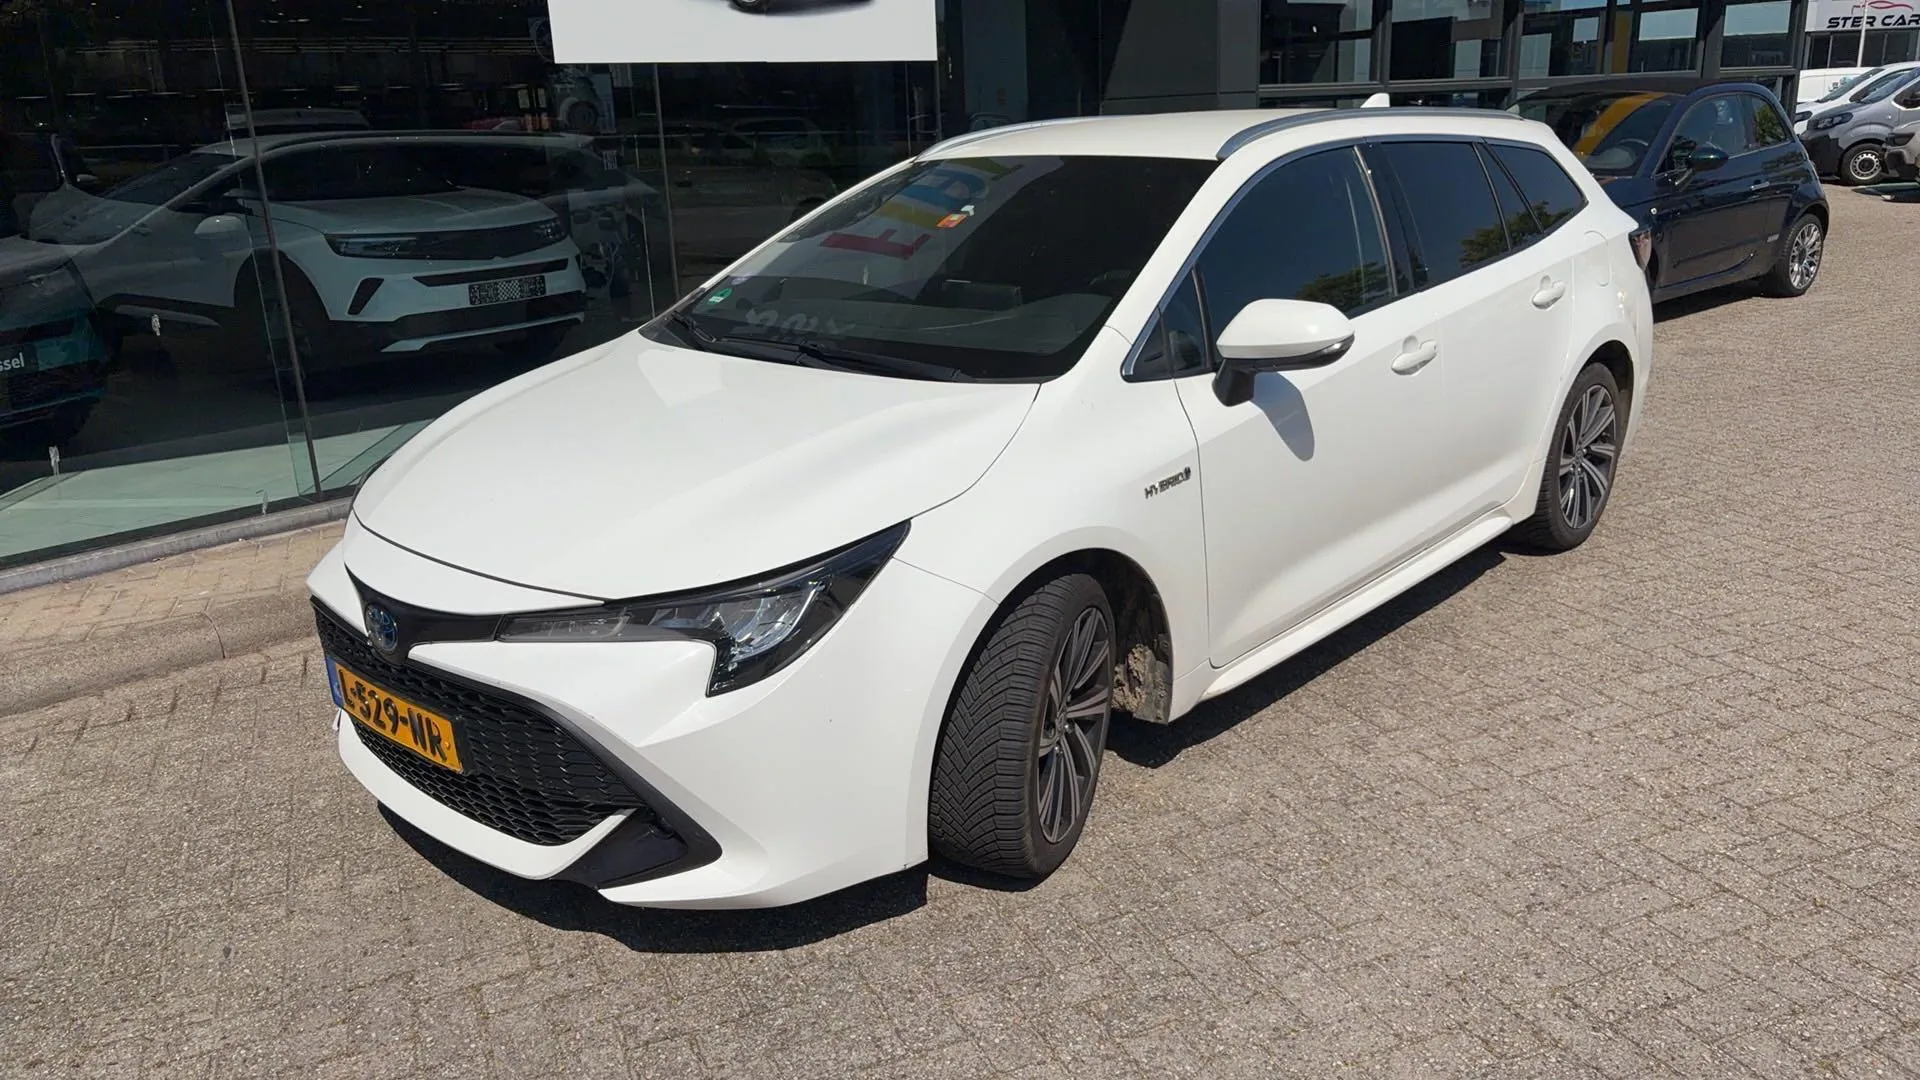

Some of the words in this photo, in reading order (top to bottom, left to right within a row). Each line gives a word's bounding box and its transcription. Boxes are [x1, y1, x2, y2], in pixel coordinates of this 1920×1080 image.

[1827, 15, 1876, 28] STER
[1881, 14, 1920, 27] CAR
[1144, 471, 1186, 499] HYBRID
[338, 668, 447, 762] L-529-NR
